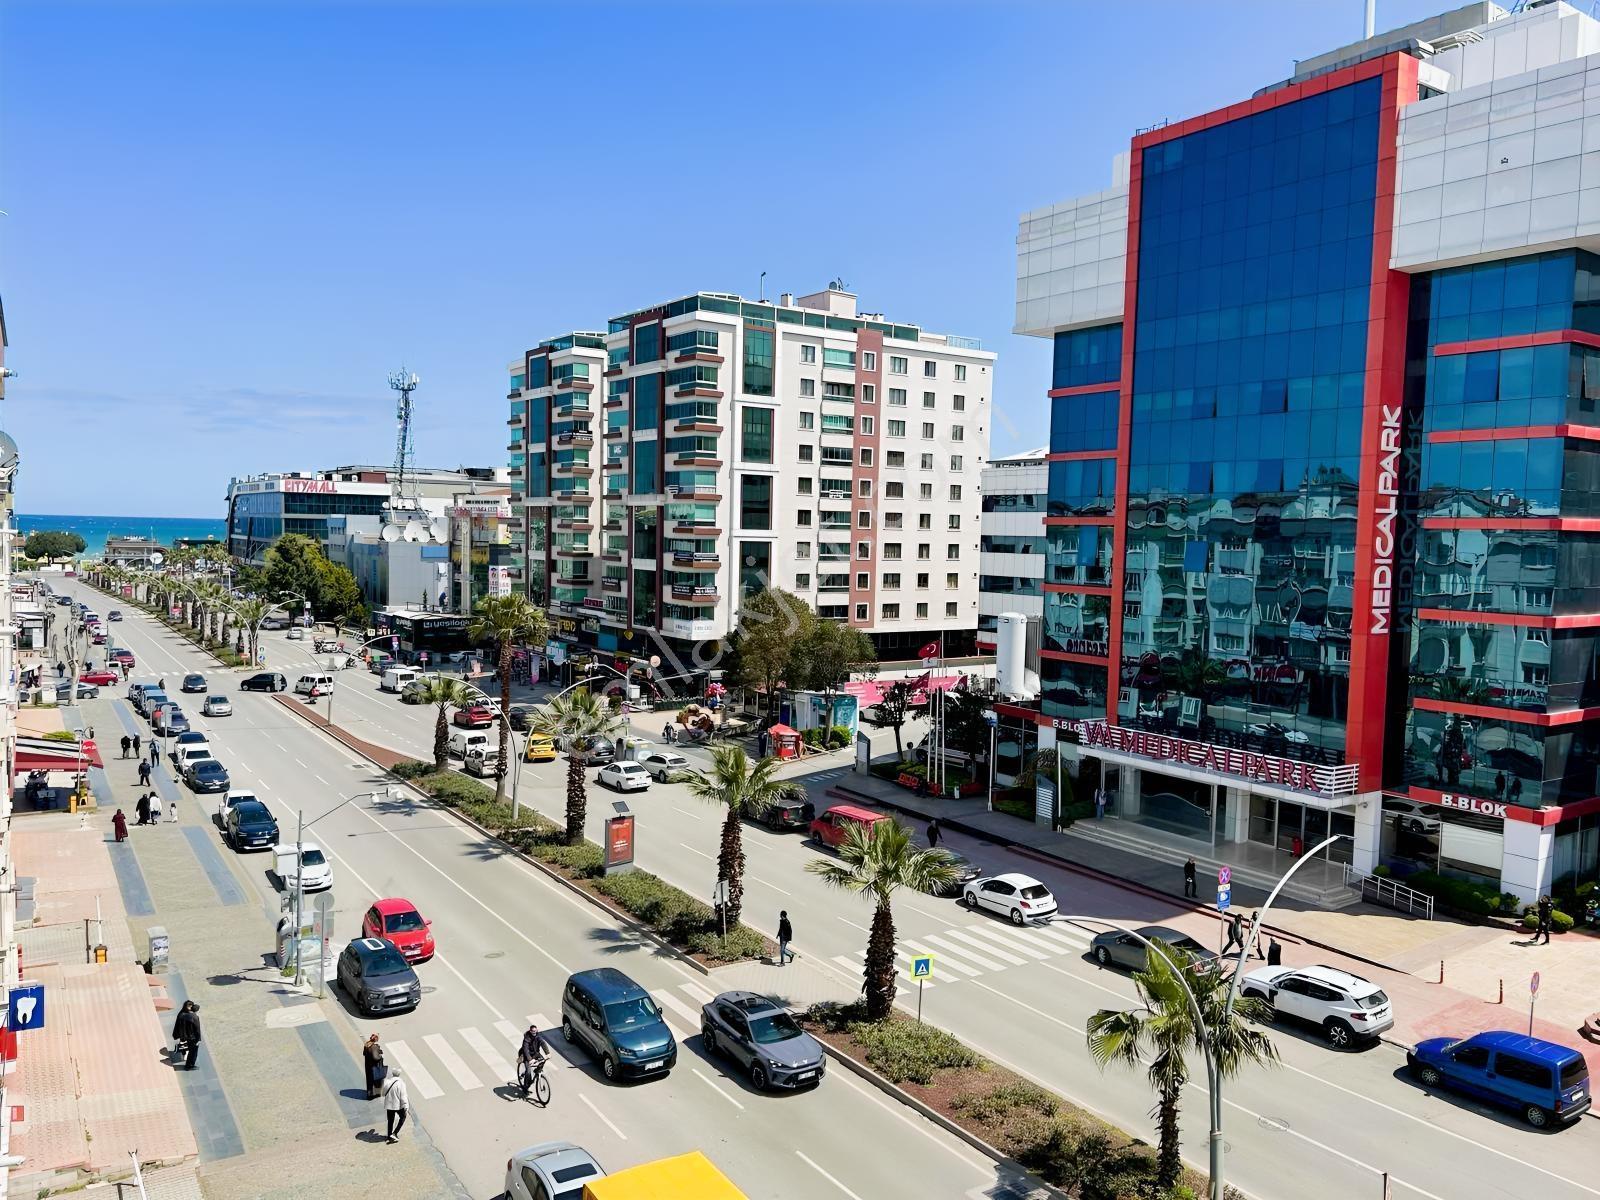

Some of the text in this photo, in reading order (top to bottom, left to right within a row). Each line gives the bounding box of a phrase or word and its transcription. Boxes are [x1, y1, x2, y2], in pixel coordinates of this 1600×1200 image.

[285, 480, 337, 493] CITYMALL
[1371, 405, 1401, 634] MEDICALPARK
[1441, 794, 1507, 818] B.BLOK
